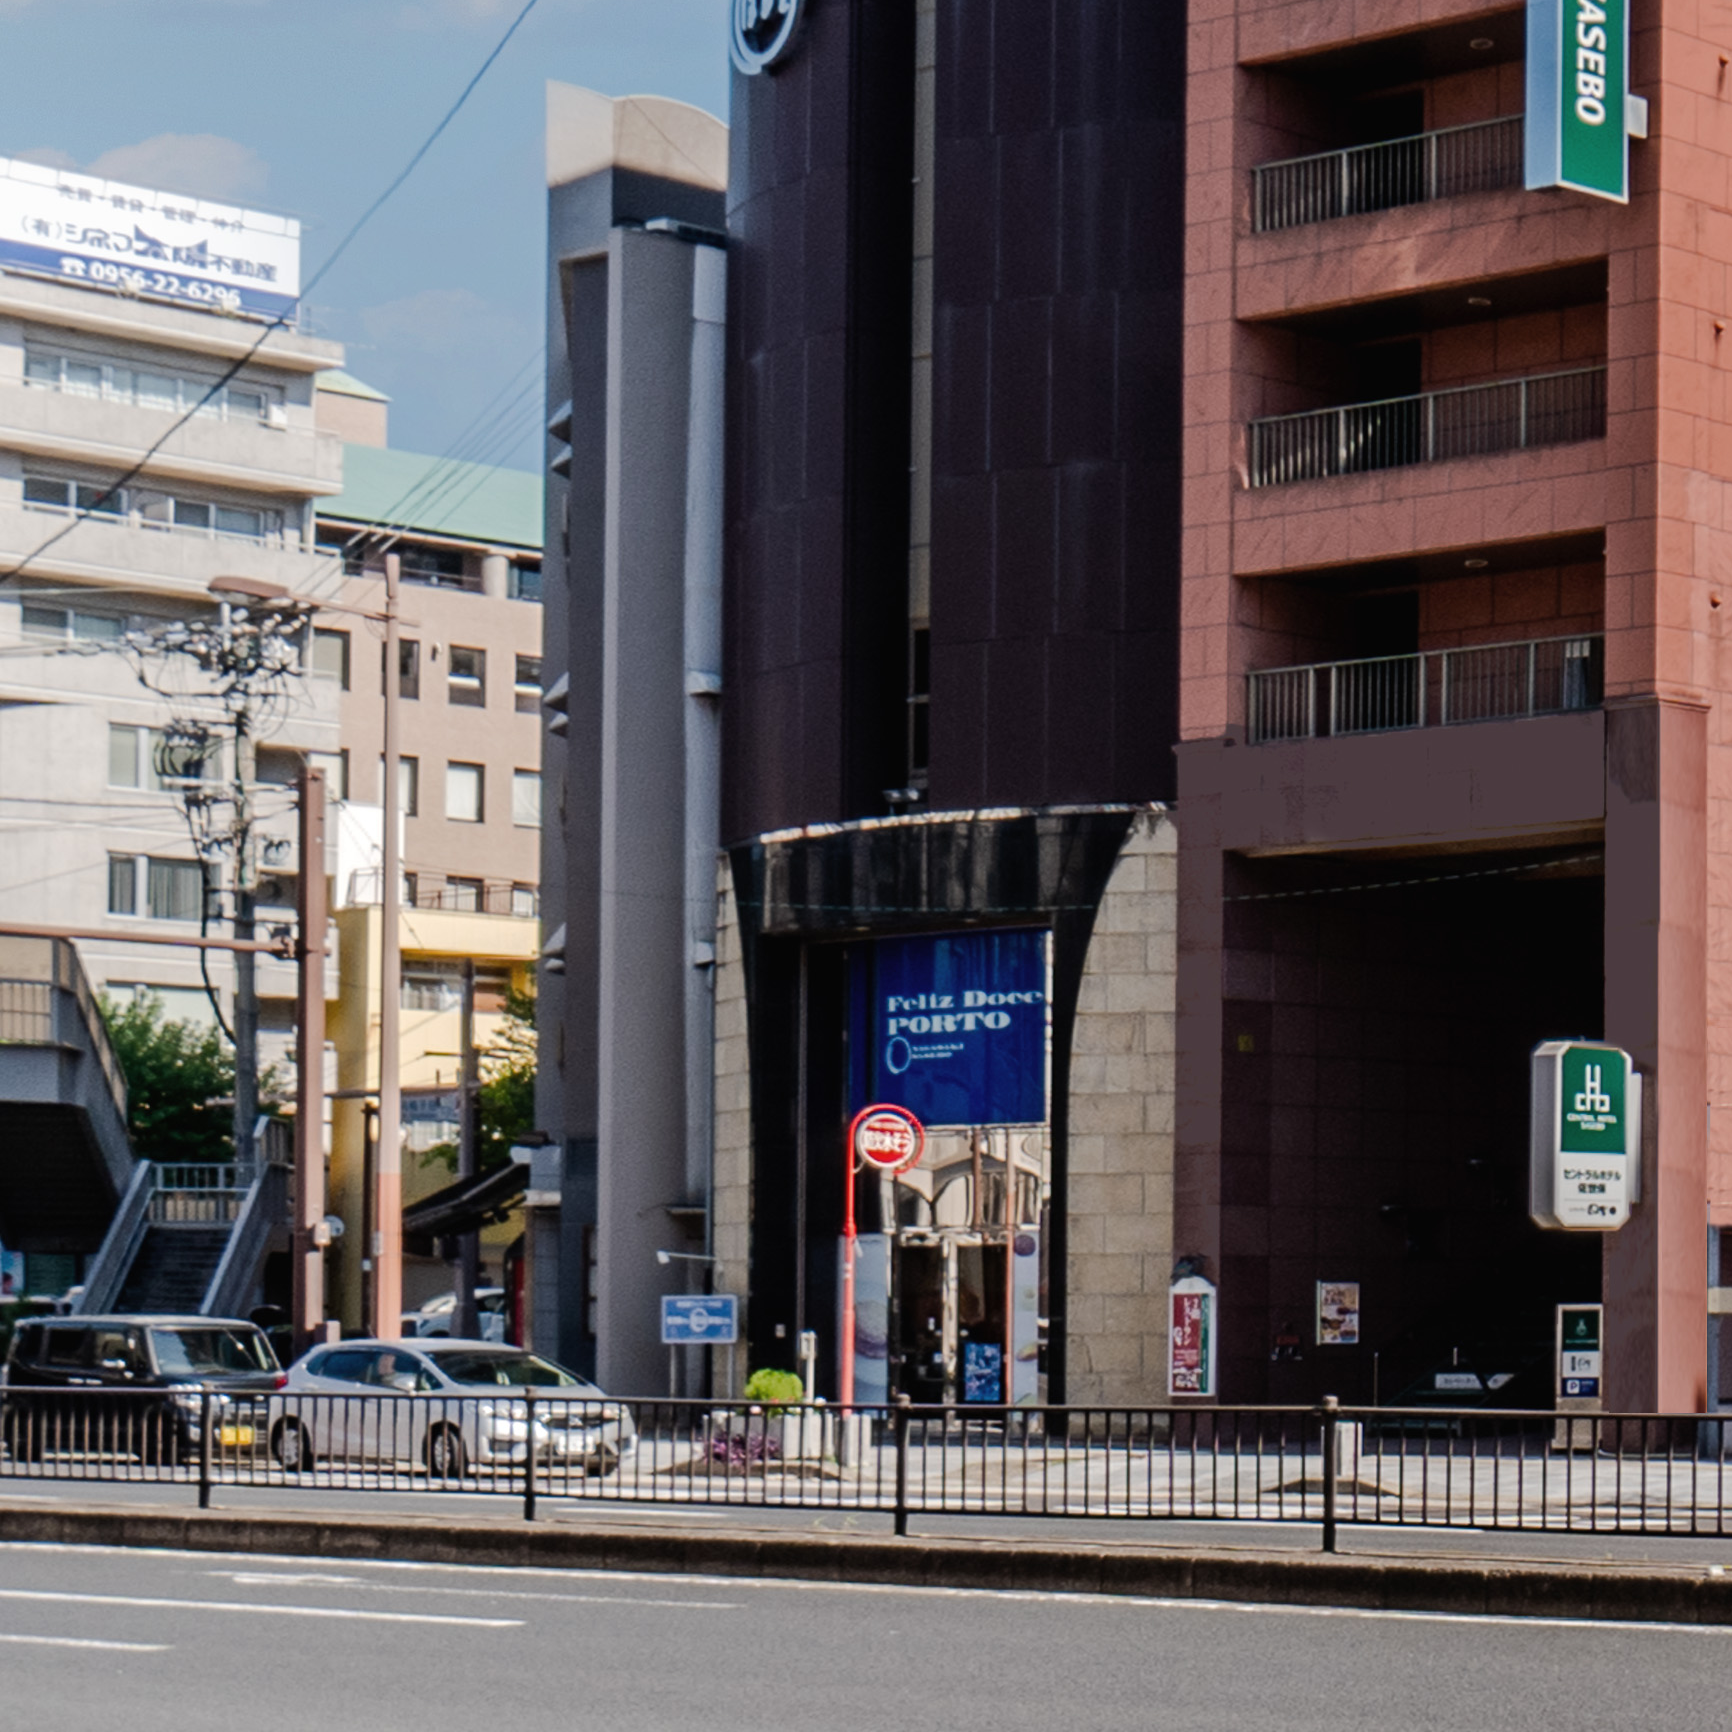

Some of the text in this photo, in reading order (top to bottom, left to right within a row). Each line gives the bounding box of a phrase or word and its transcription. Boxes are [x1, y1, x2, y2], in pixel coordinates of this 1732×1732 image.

[90, 261, 242, 309] 0956-22-6296
[887, 989, 1044, 1013] Feliz Doce
[887, 1010, 1012, 1036] PORTO
